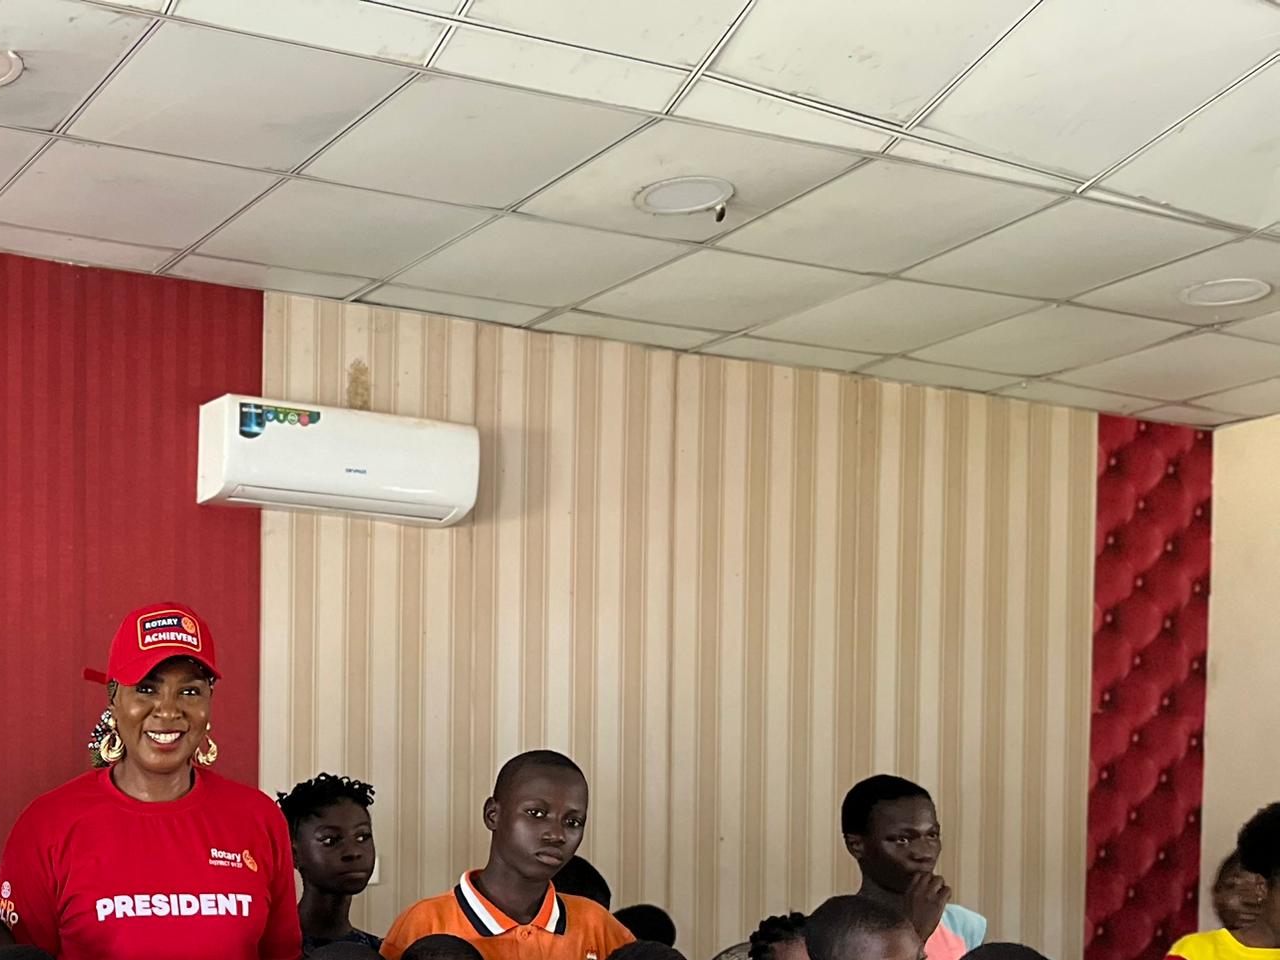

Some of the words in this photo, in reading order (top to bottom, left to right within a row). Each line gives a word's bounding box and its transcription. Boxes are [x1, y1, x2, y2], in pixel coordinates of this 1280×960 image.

[145, 618, 178, 630] ROTARY
[144, 631, 198, 645] ACHIEVERS
[210, 848, 241, 863] Rotary
[96, 893, 253, 921] PRESIDENT
